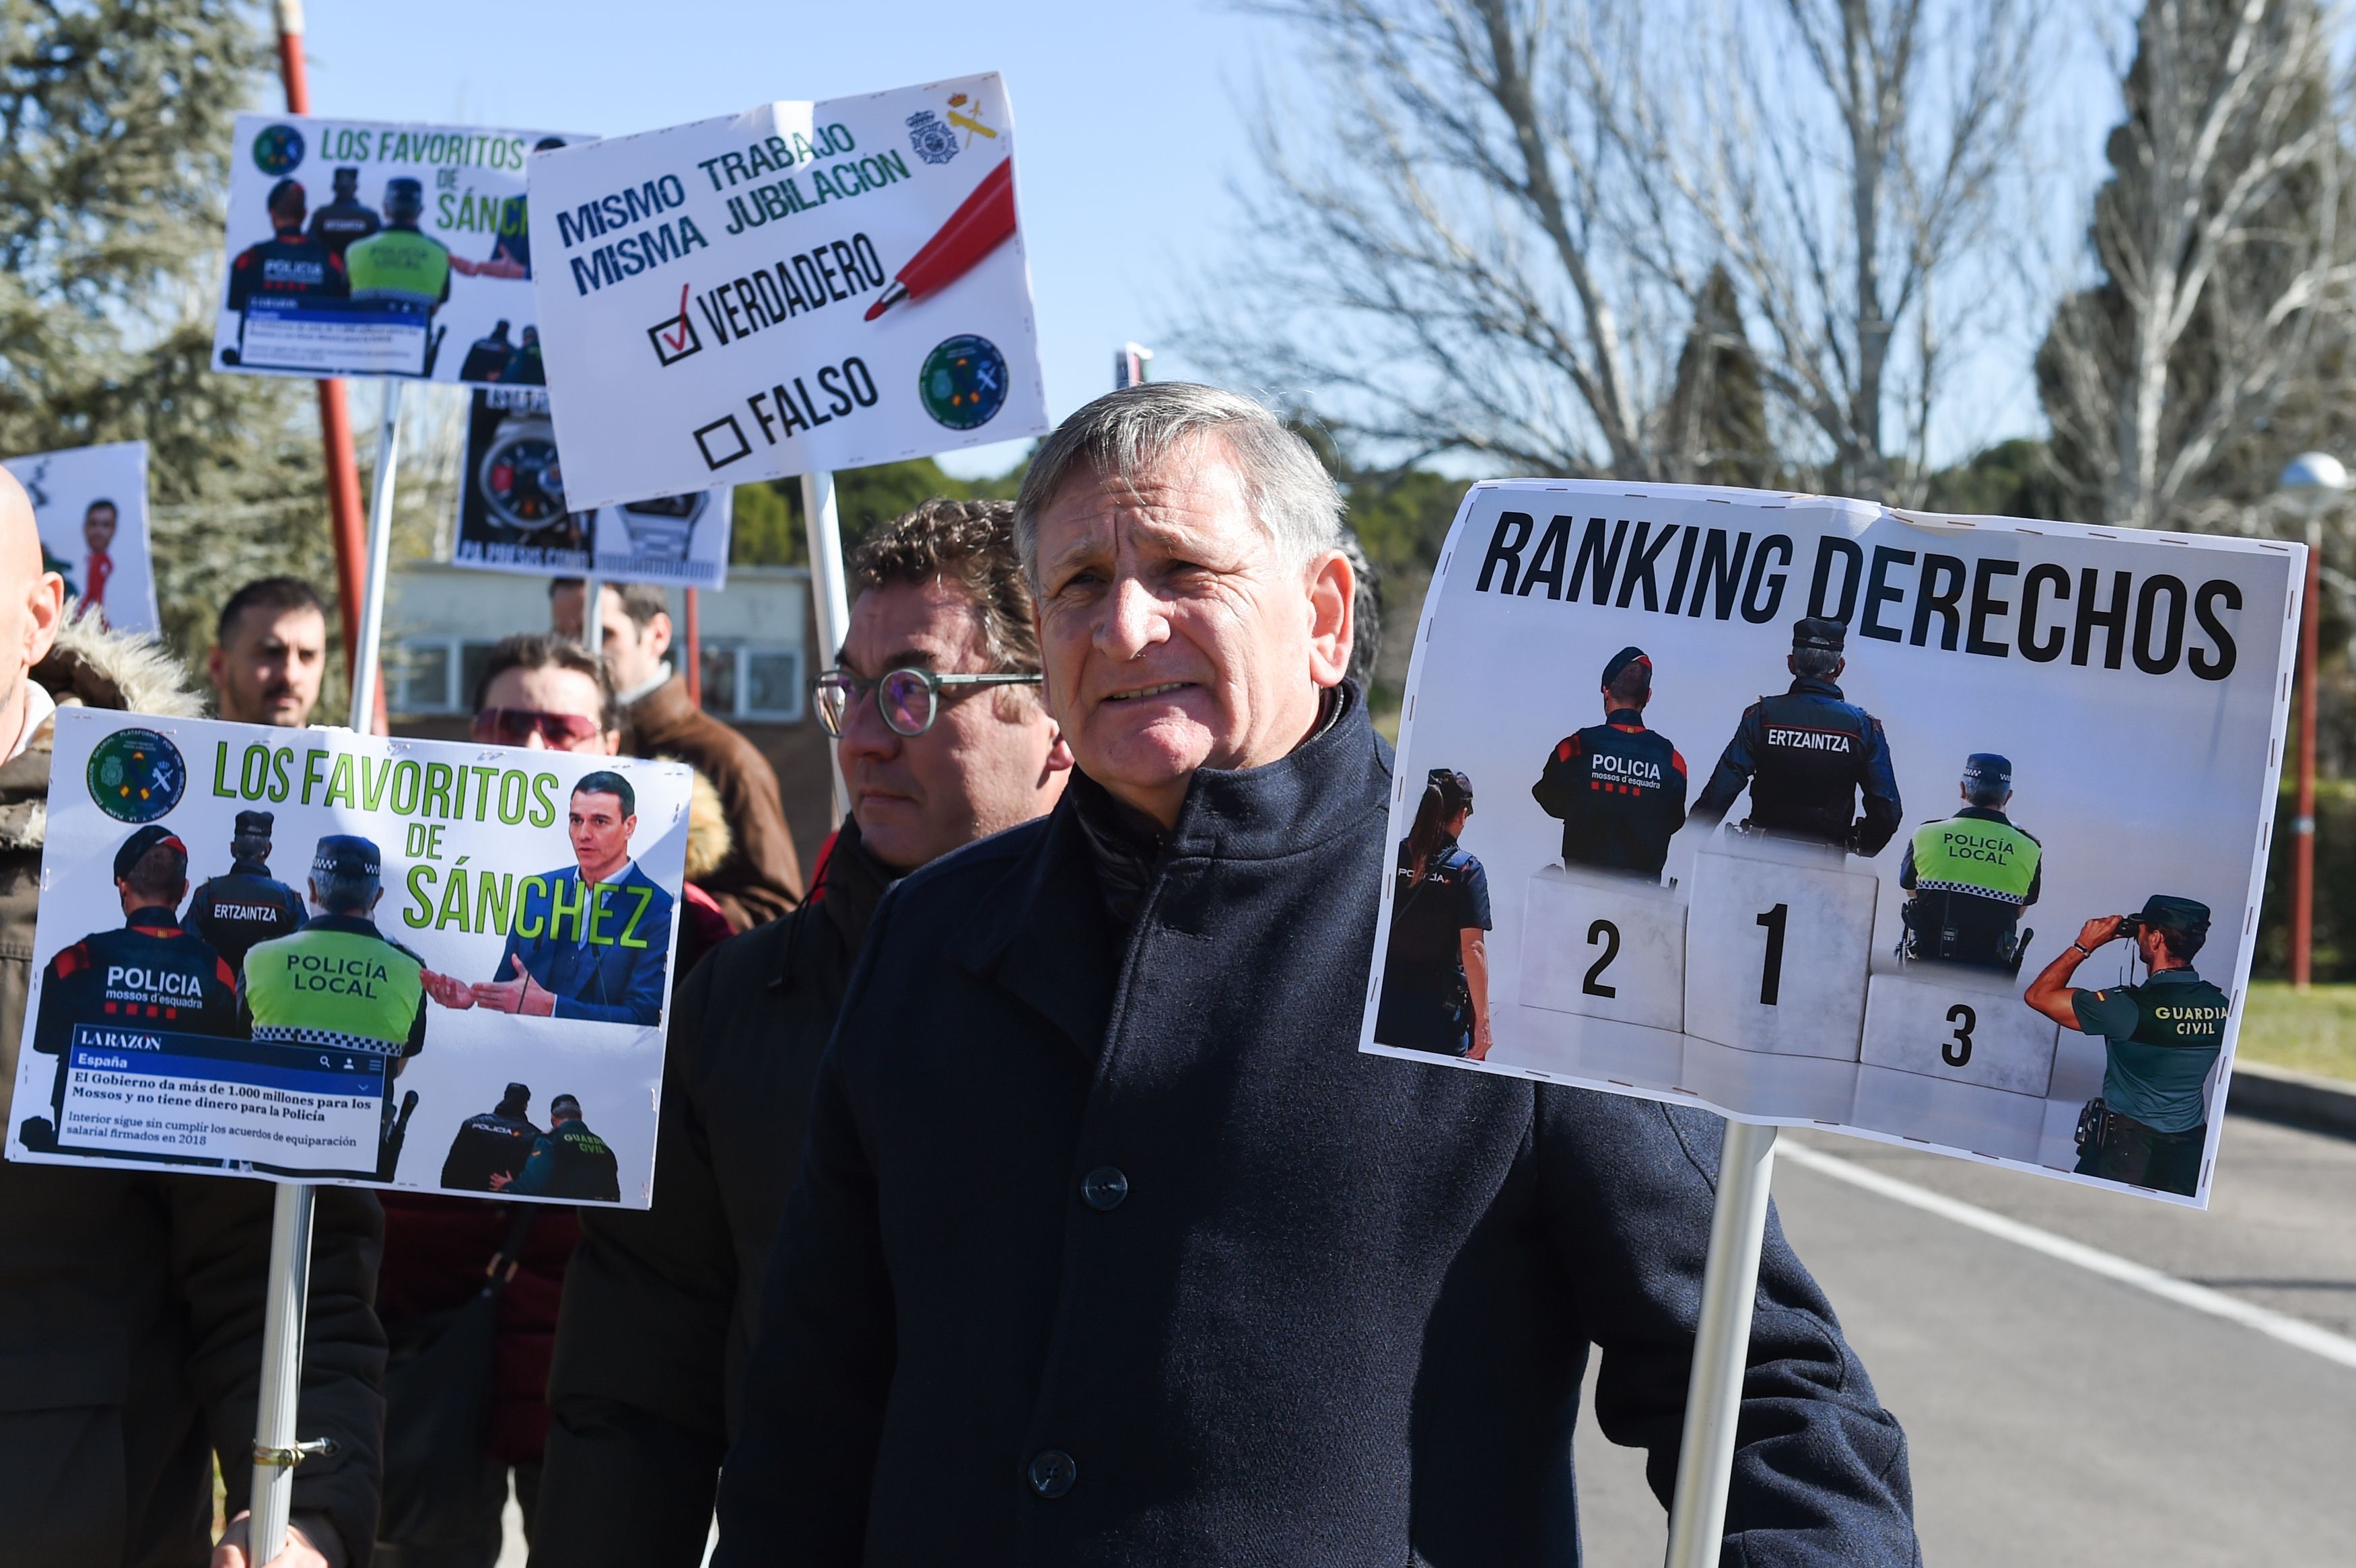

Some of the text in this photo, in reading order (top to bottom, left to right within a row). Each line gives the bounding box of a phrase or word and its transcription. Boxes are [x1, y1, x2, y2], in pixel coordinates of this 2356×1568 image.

[320, 128, 525, 170] LOS FAVORITOS
[437, 168, 459, 190] DE
[556, 123, 856, 248] MISMO TRABAJO
[569, 149, 911, 297] MISMA JUBILACIÓN
[696, 233, 885, 346] VERDADERO
[747, 357, 878, 445] FALSO
[1475, 511, 2243, 681] RANKING DERECHOS
[120, 729, 158, 740] PLATAFORMA
[1768, 729, 1850, 753] ERTZAINTZA
[1591, 772, 1620, 782] mossos
[1592, 754, 1661, 780] POLICIA
[213, 741, 559, 828] LOS FAVORITOS
[406, 823, 444, 860] DE
[1943, 833, 2014, 855] POLICÍA
[1949, 845, 2007, 865] LOCAL
[213, 904, 277, 923] ERTZAINTZA
[403, 856, 653, 948] SÁNCHEZ
[1582, 919, 1620, 999] 2
[1756, 903, 1788, 1006] 1
[107, 966, 202, 997] POLICIA
[287, 954, 388, 983] POLICÍA
[106, 989, 148, 1002] mossos
[294, 973, 378, 999] LOCAL
[2155, 1007, 2228, 1020] GUARDIA
[81, 1030, 162, 1051] LA RAZÓN
[1941, 1004, 1976, 1067] 3
[2176, 1023, 2215, 1034] CIVIL
[78, 1053, 127, 1069] España
[72, 1086, 325, 1122] Mossos y no tiene dinero para la Policía
[75, 1072, 372, 1109] El Gobierno da más de 1.000 millones para los
[67, 1125, 207, 1145] salarial firmados en 2018
[69, 1112, 356, 1148] Interior sigue sin cumplir los acuerdos de equiparación
[472, 1123, 512, 1135] POLICIA
[580, 1143, 605, 1153] CIVIL
